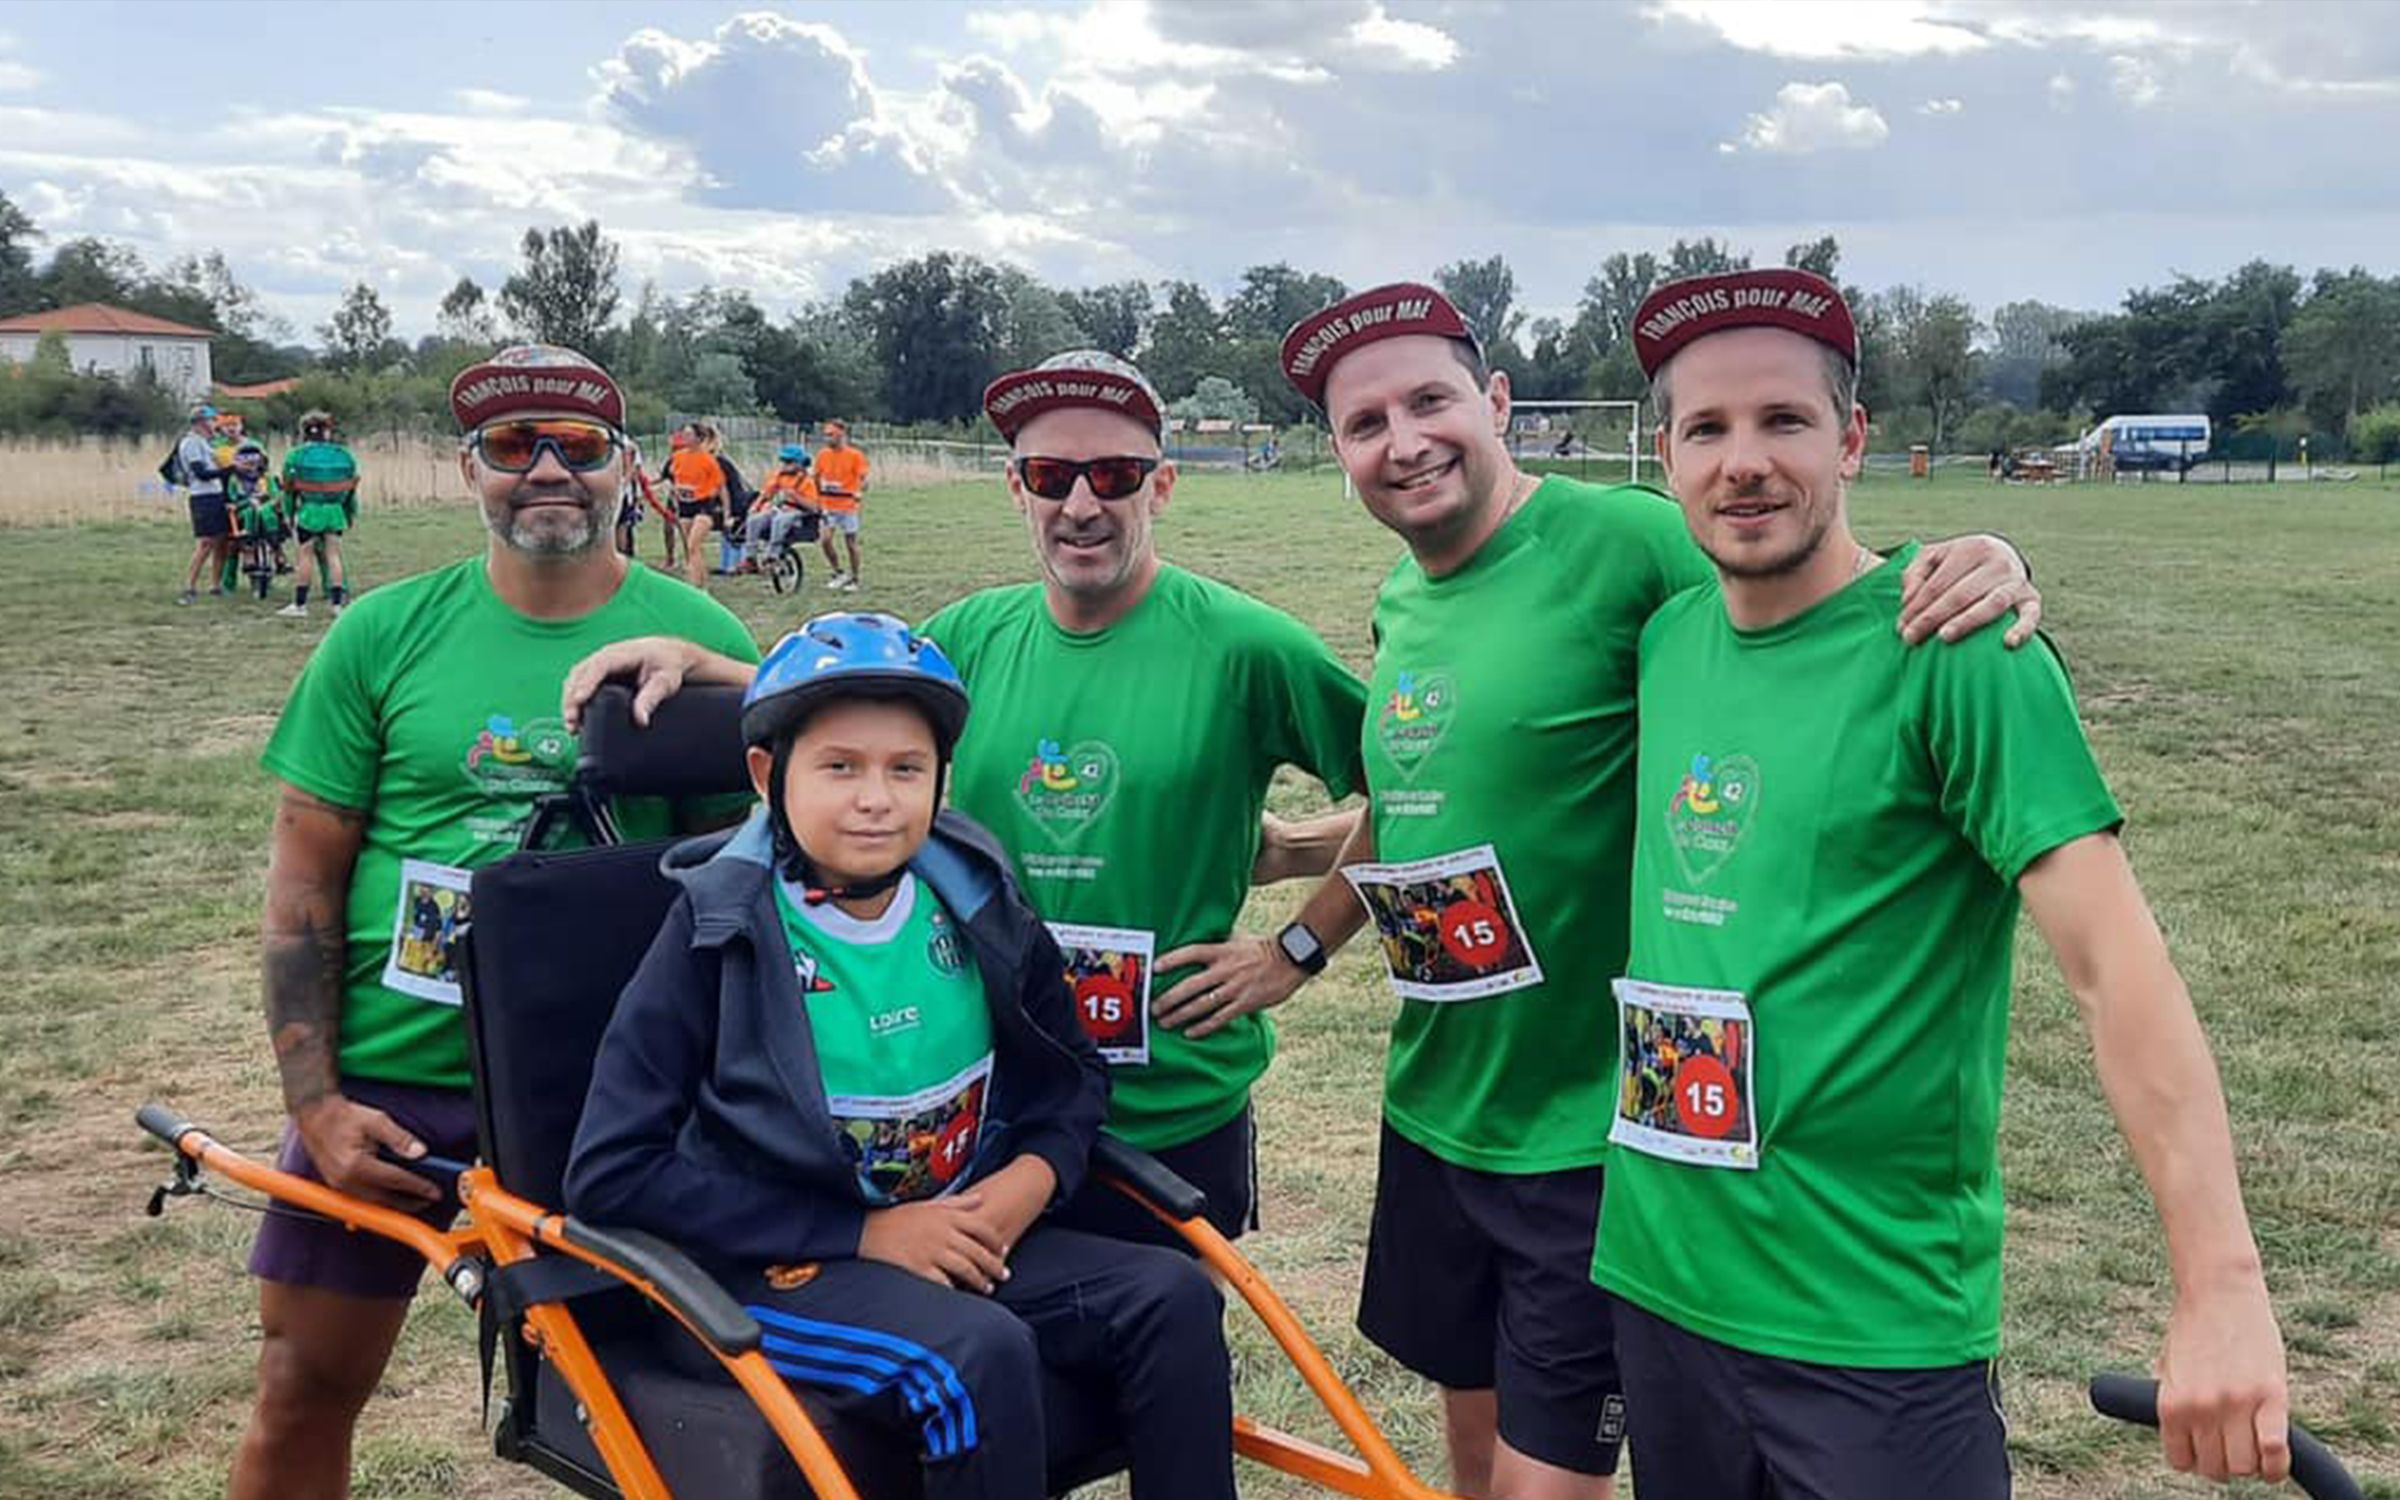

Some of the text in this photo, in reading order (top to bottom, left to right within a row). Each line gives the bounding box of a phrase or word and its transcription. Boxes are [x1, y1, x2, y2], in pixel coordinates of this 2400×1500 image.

[1350, 304, 1395, 332] pour
[1639, 287, 1730, 341] FRANÇOIS
[1733, 287, 1789, 310] pour
[533, 377, 578, 394] pour
[1455, 920, 1496, 949] 15
[1084, 995, 1120, 1021] 15
[1686, 1081, 1724, 1117] 15
